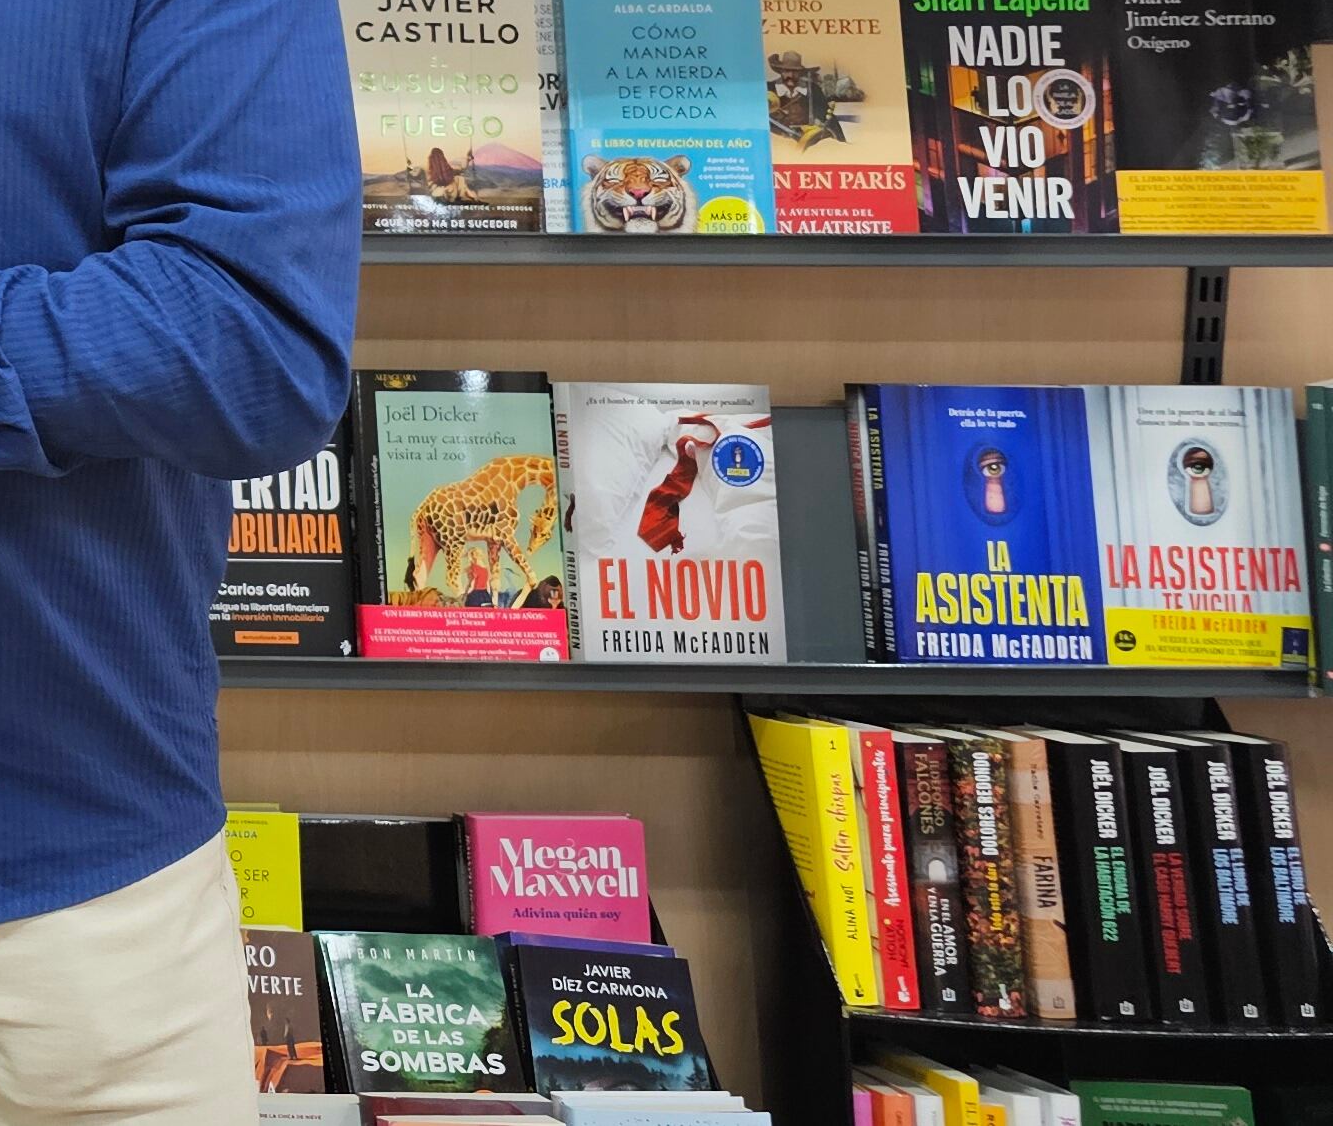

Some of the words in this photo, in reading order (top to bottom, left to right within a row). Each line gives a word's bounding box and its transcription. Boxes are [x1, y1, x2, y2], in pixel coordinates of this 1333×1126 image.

[614, 3, 648, 13] ALBA
[652, 3, 713, 13] CARDALDA
[632, 21, 696, 40] CÓMO
[1124, 9, 1199, 30] Jiménez
[1204, 9, 1275, 27] Serrano
[355, 21, 519, 44] CASTILLO
[1127, 35, 1190, 50] Oxígeno
[623, 45, 707, 60] MANDAR
[948, 25, 1065, 67] NADIE
[606, 67, 620, 79] A
[625, 66, 648, 79] LA
[655, 66, 727, 80] MIERDA
[619, 86, 642, 99] DE
[648, 86, 717, 99] FORMA
[987, 75, 1033, 117] LO
[621, 104, 717, 119] EDUCADA
[591, 139, 602, 148] EL
[604, 139, 634, 149] LIBRO
[637, 136, 702, 149] REVELACIÓN
[704, 139, 722, 149] DEL
[725, 136, 751, 149] AÑO
[980, 125, 1044, 168] VIO
[957, 177, 1074, 219] VENIR
[385, 405, 415, 423] Joël
[421, 405, 478, 424] Dicker
[386, 432, 402, 445] La
[407, 435, 437, 450] muy
[442, 432, 516, 446] catastrófica
[387, 448, 419, 461] visita
[426, 448, 439, 461] al
[442, 451, 465, 462] zoo
[986, 540, 1010, 572] LA
[600, 558, 636, 620] EL
[649, 559, 767, 622] NOVIO
[915, 573, 1089, 627] ASISTENTA
[602, 630, 665, 653] FREIDA
[674, 631, 769, 655] McFADDEN
[917, 632, 985, 659] FREIDA
[992, 633, 1092, 660] McFADDEN
[500, 837, 622, 872] Megan
[490, 865, 638, 898] Maxwell
[512, 908, 559, 920] Adivina
[564, 907, 598, 922] quién
[600, 910, 621, 921] soy
[583, 963, 632, 980] JAVIER
[405, 983, 433, 999] LA
[552, 975, 583, 993] DÍEZ
[587, 980, 668, 999] CARMONA
[361, 996, 489, 1026] FÁBRICA
[393, 1029, 419, 1044] DE
[425, 1030, 464, 1045] LAS
[552, 1000, 684, 1055] SOLAS
[361, 1050, 506, 1075] SOMBRAS
